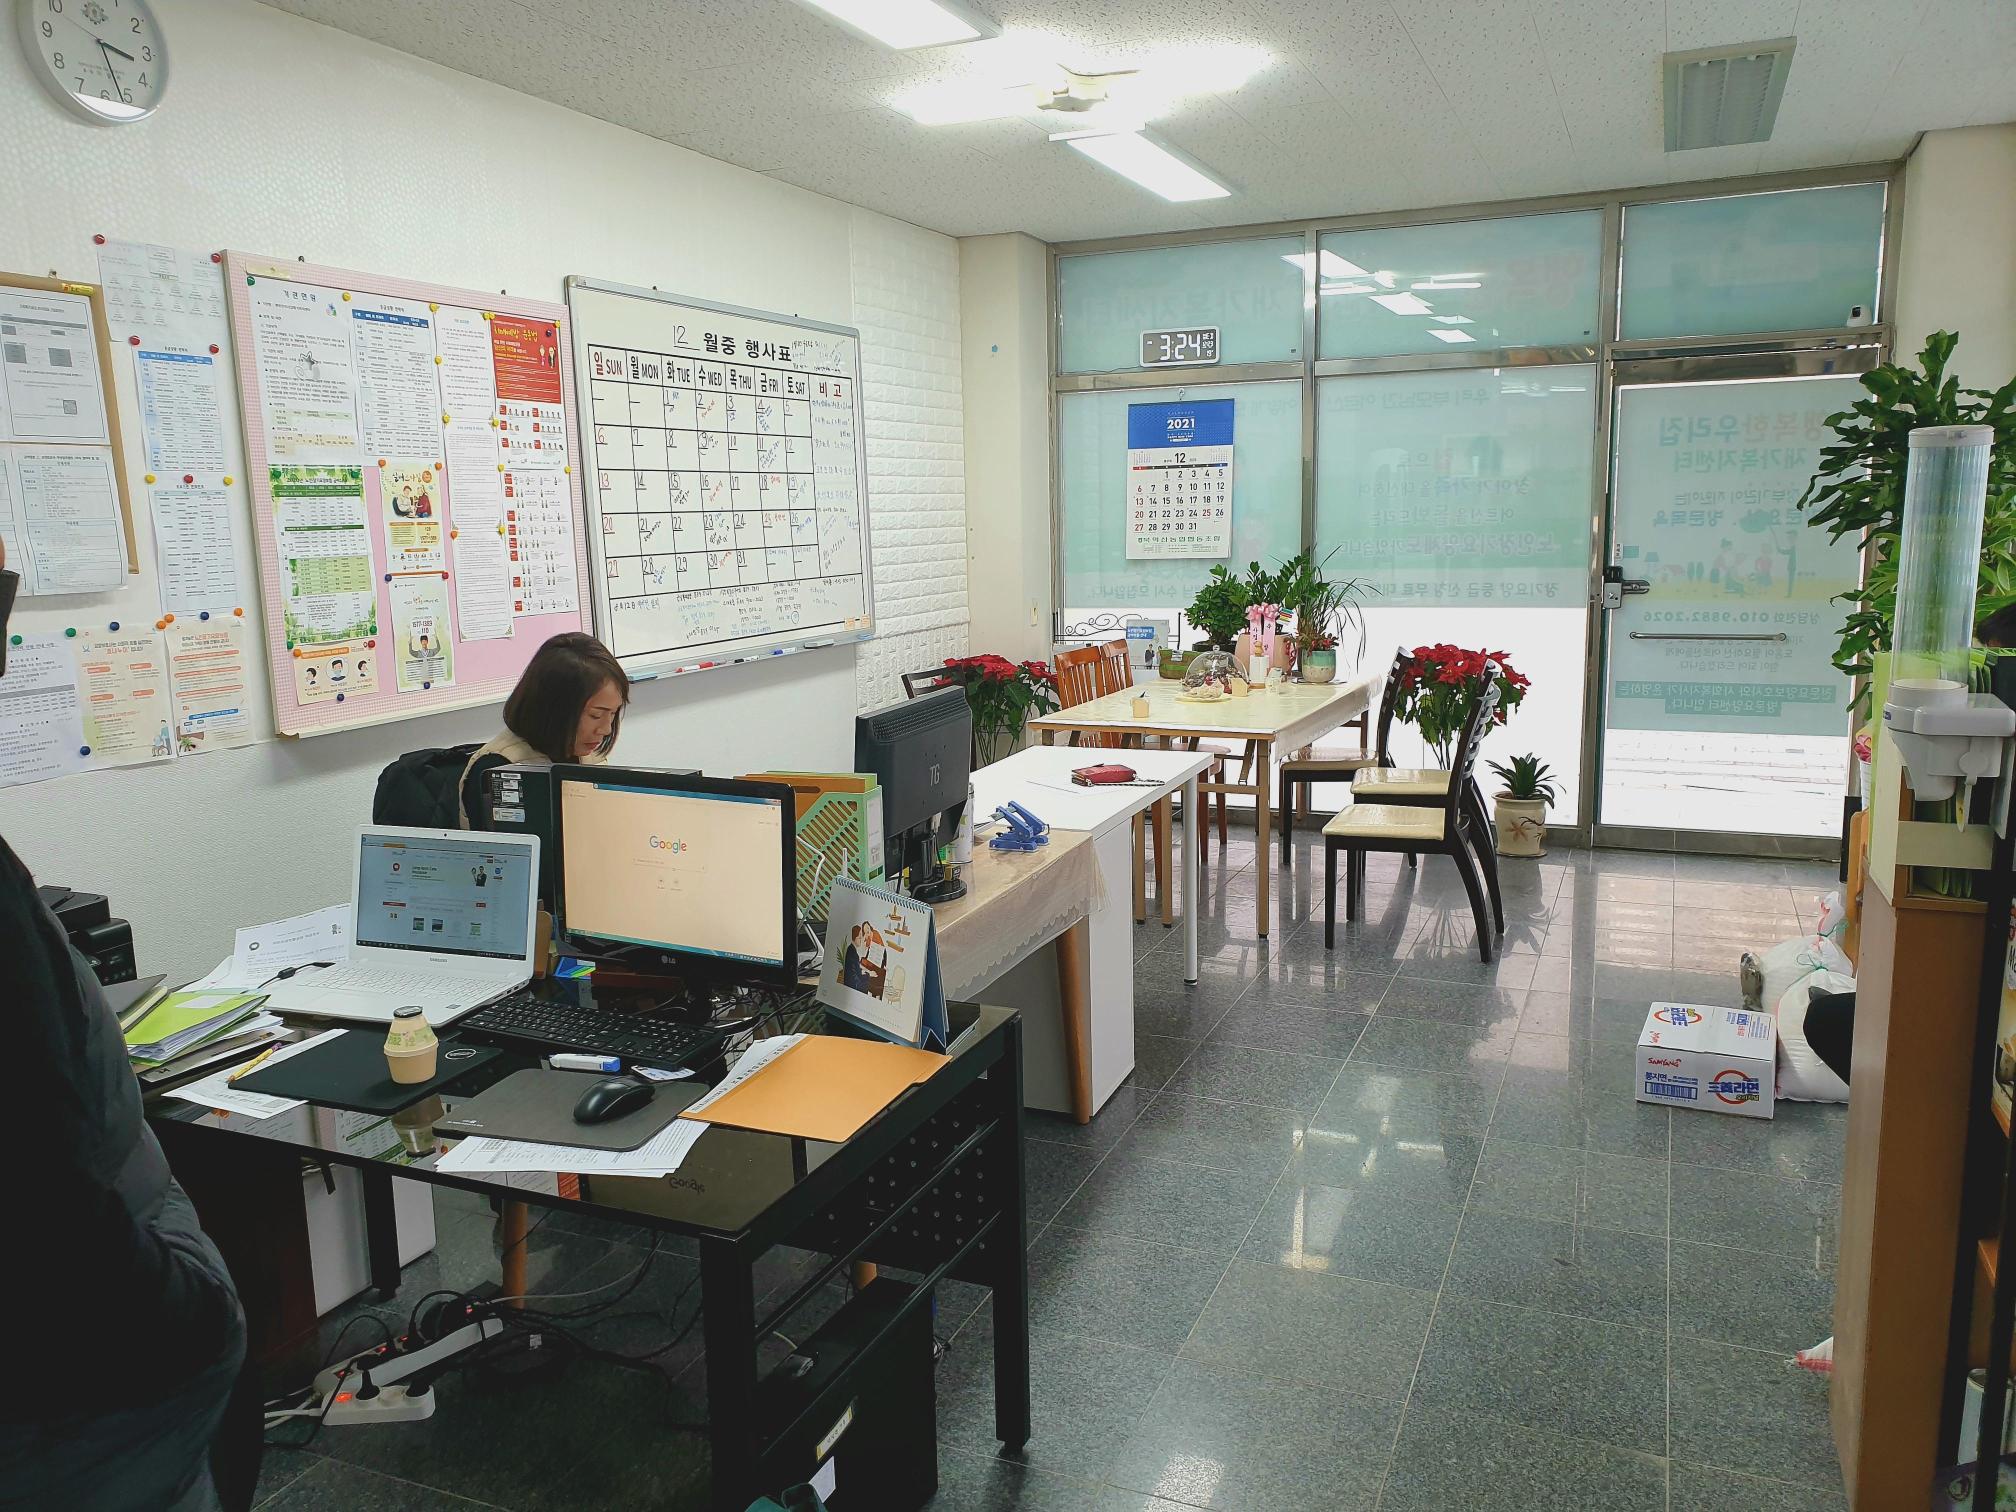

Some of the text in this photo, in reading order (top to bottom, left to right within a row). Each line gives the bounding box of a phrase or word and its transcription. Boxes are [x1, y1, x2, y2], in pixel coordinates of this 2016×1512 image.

[42, 20, 52, 38] 9
[130, 17, 141, 34] 2
[54, 52, 65, 69] 8
[141, 45, 152, 62] 3
[74, 77, 85, 93] 7
[138, 72, 148, 87] 4
[123, 88, 133, 103] 5
[672, 325, 689, 345] 12
[703, 331, 736, 357] 월중
[745, 338, 792, 363] 행사표
[1160, 333, 1201, 360] 3:24
[593, 351, 623, 376] 일 SUN
[630, 355, 659, 380] 월 MON
[666, 360, 691, 383] 화 TUE
[698, 364, 723, 387] 수 WED
[729, 368, 752, 390] 목 THU
[760, 372, 779, 393] 금 FRI
[787, 376, 806, 395] 토 SAT
[697, 392, 704, 406] 2
[727, 396, 735, 410] 3
[757, 399, 765, 411] 4
[1167, 418, 1195, 430] 2021
[597, 428, 606, 444] 6
[633, 428, 640, 445] 7
[667, 429, 674, 447] 8
[1174, 452, 1186, 464] 12
[600, 473, 610, 489] 13
[670, 472, 680, 489] 15
[701, 474, 709, 488] 16
[731, 475, 739, 489] 17
[1191, 470, 1196, 478] 3
[760, 475, 768, 490] 18
[1217, 482, 1225, 490] 12
[1149, 497, 1157, 505] 14
[1163, 497, 1170, 505] 15
[1190, 496, 1198, 504] 17
[1217, 495, 1224, 503] 19
[603, 515, 613, 532] 20
[639, 515, 648, 532] 21
[673, 515, 682, 530] 22
[704, 514, 714, 529] 23
[735, 514, 747, 529] 24
[1188, 522, 1197, 530] 31
[643, 557, 654, 574] 28
[676, 557, 688, 572] 29
[708, 554, 718, 570] 30
[737, 552, 745, 567] 31
[607, 560, 619, 577] 27
[929, 764, 941, 786] TG
[649, 835, 687, 854] Google
[1648, 1057, 1681, 1068] SAMYANG
